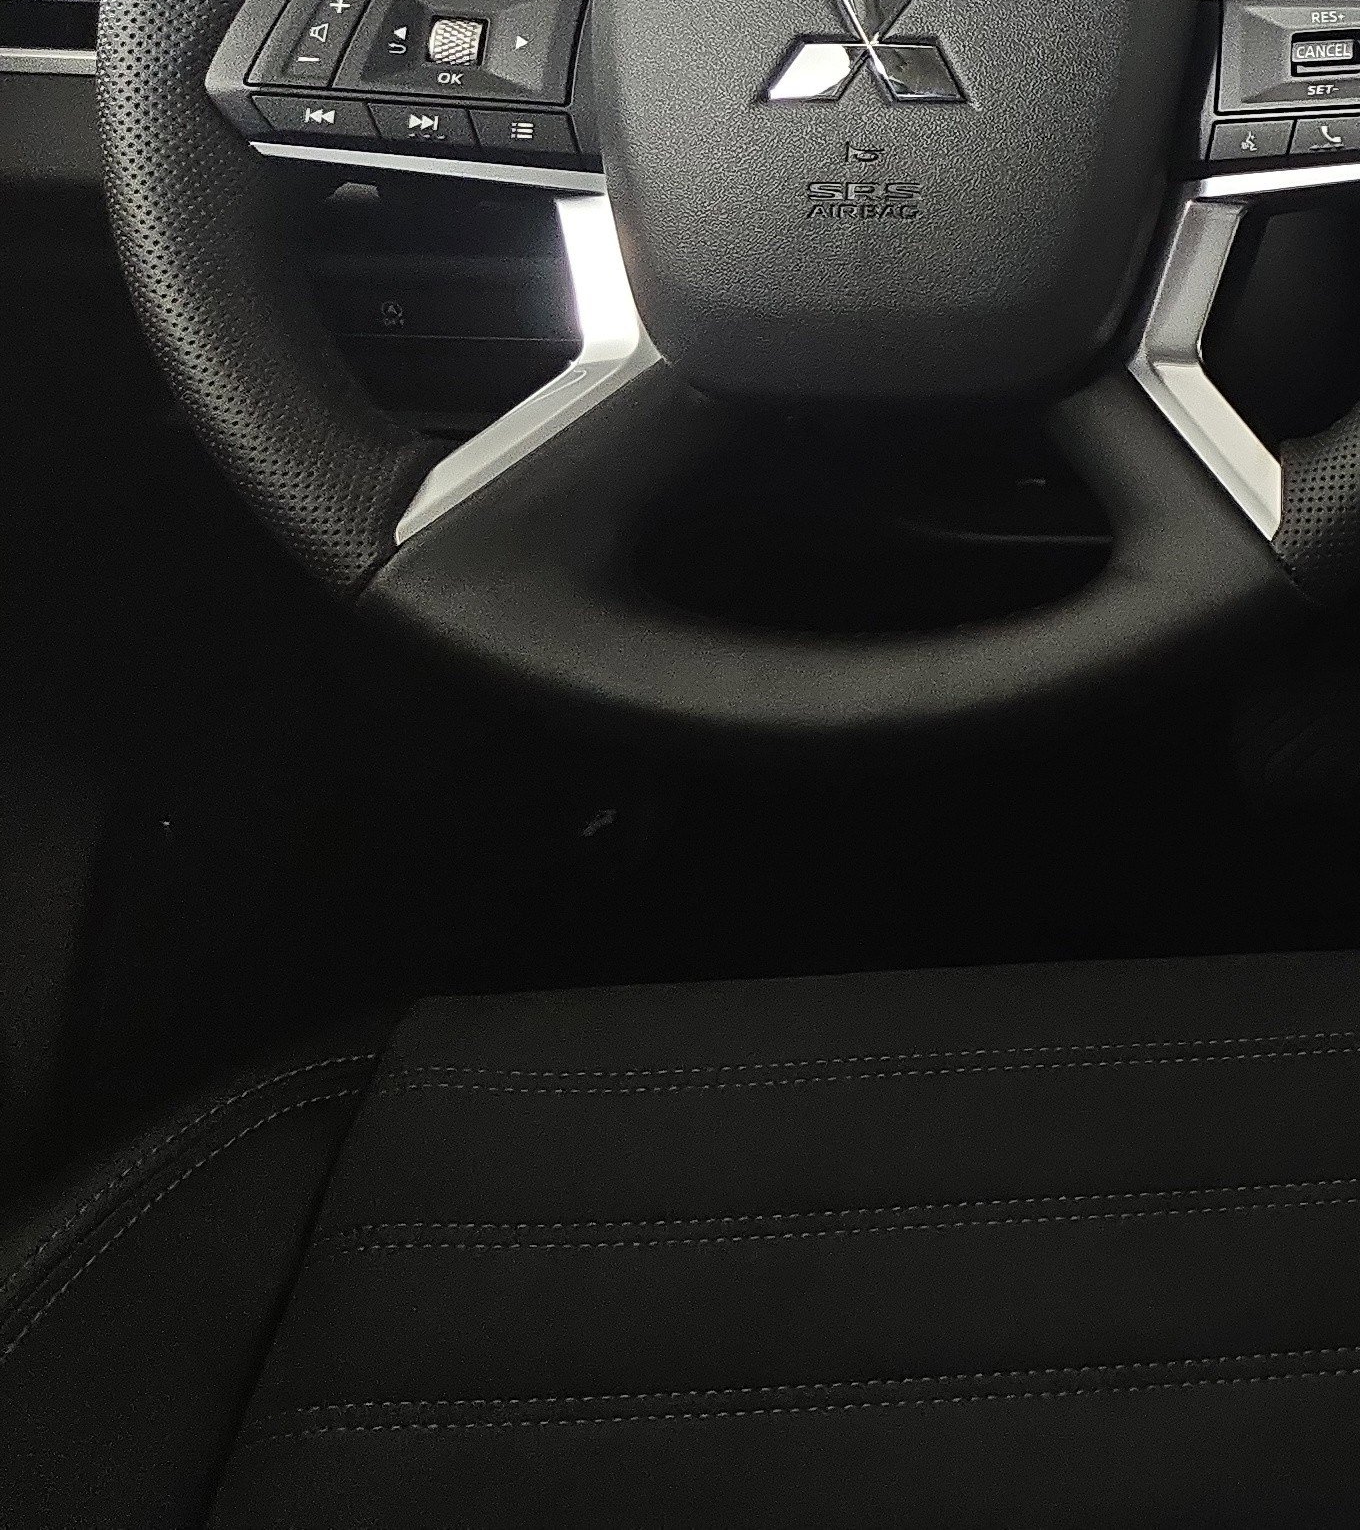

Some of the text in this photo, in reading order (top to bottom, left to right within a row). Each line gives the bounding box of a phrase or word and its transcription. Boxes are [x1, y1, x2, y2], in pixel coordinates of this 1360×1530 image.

[1296, 42, 1351, 59] CANCEL
[437, 71, 464, 86] OK
[808, 181, 921, 201] SRS
[808, 203, 921, 220] AIRBAG
